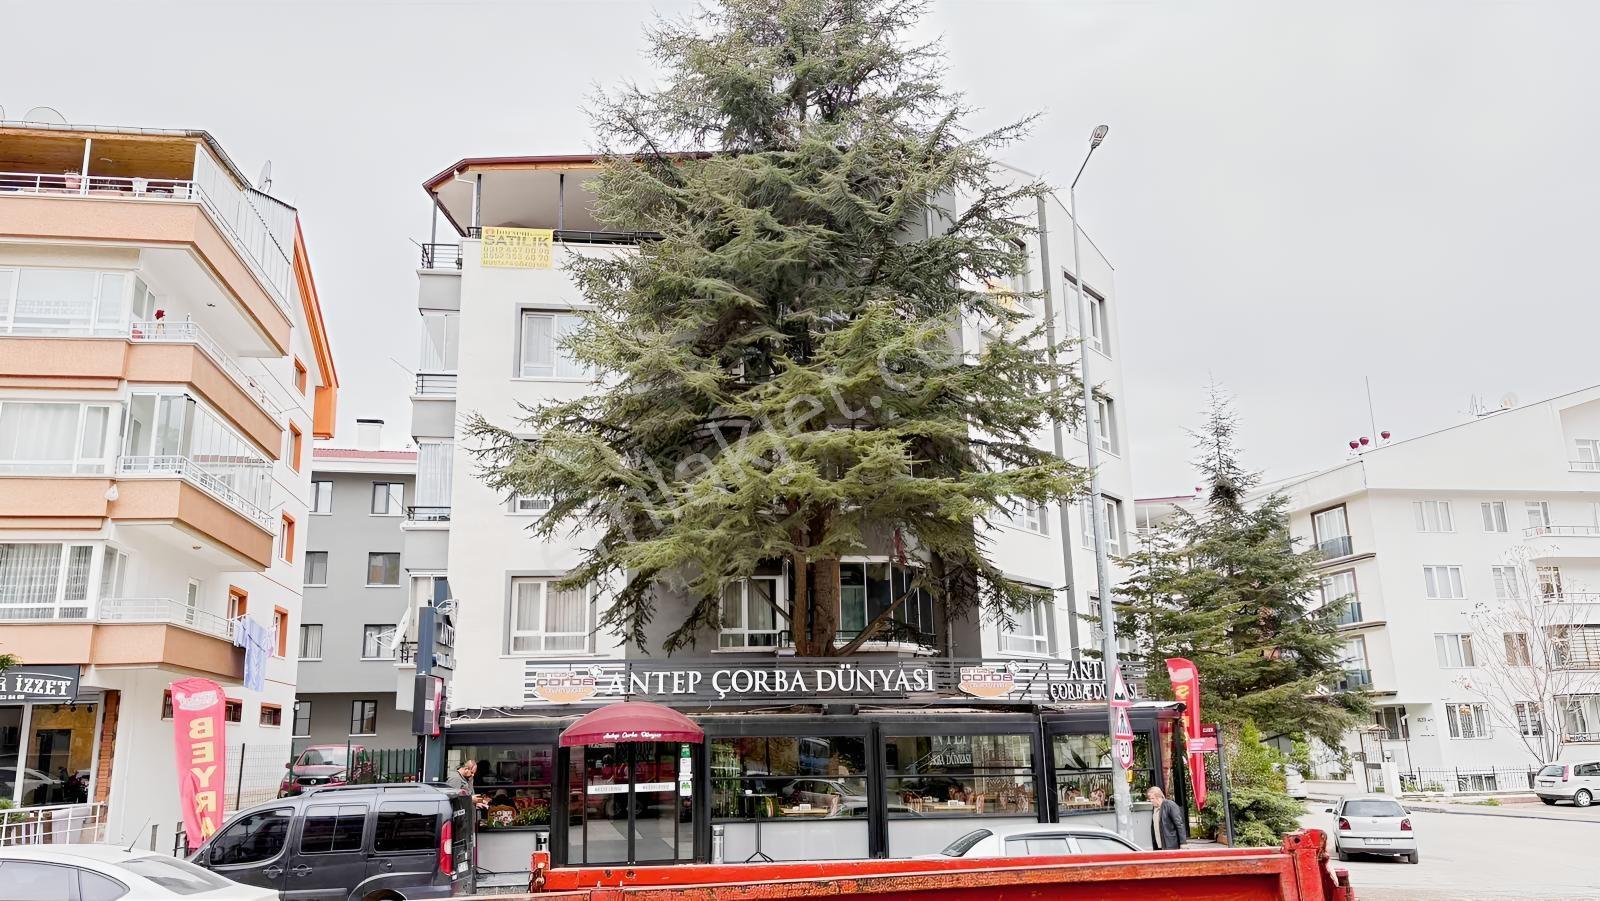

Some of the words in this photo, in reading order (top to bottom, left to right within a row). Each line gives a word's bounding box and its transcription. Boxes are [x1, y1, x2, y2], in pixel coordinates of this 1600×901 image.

[484, 234, 550, 247] SATILIK
[14, 674, 73, 696] İZZET
[605, 671, 703, 696] ANTEP
[711, 669, 808, 699] ÇORBA
[816, 664, 936, 693] DÜNYASI
